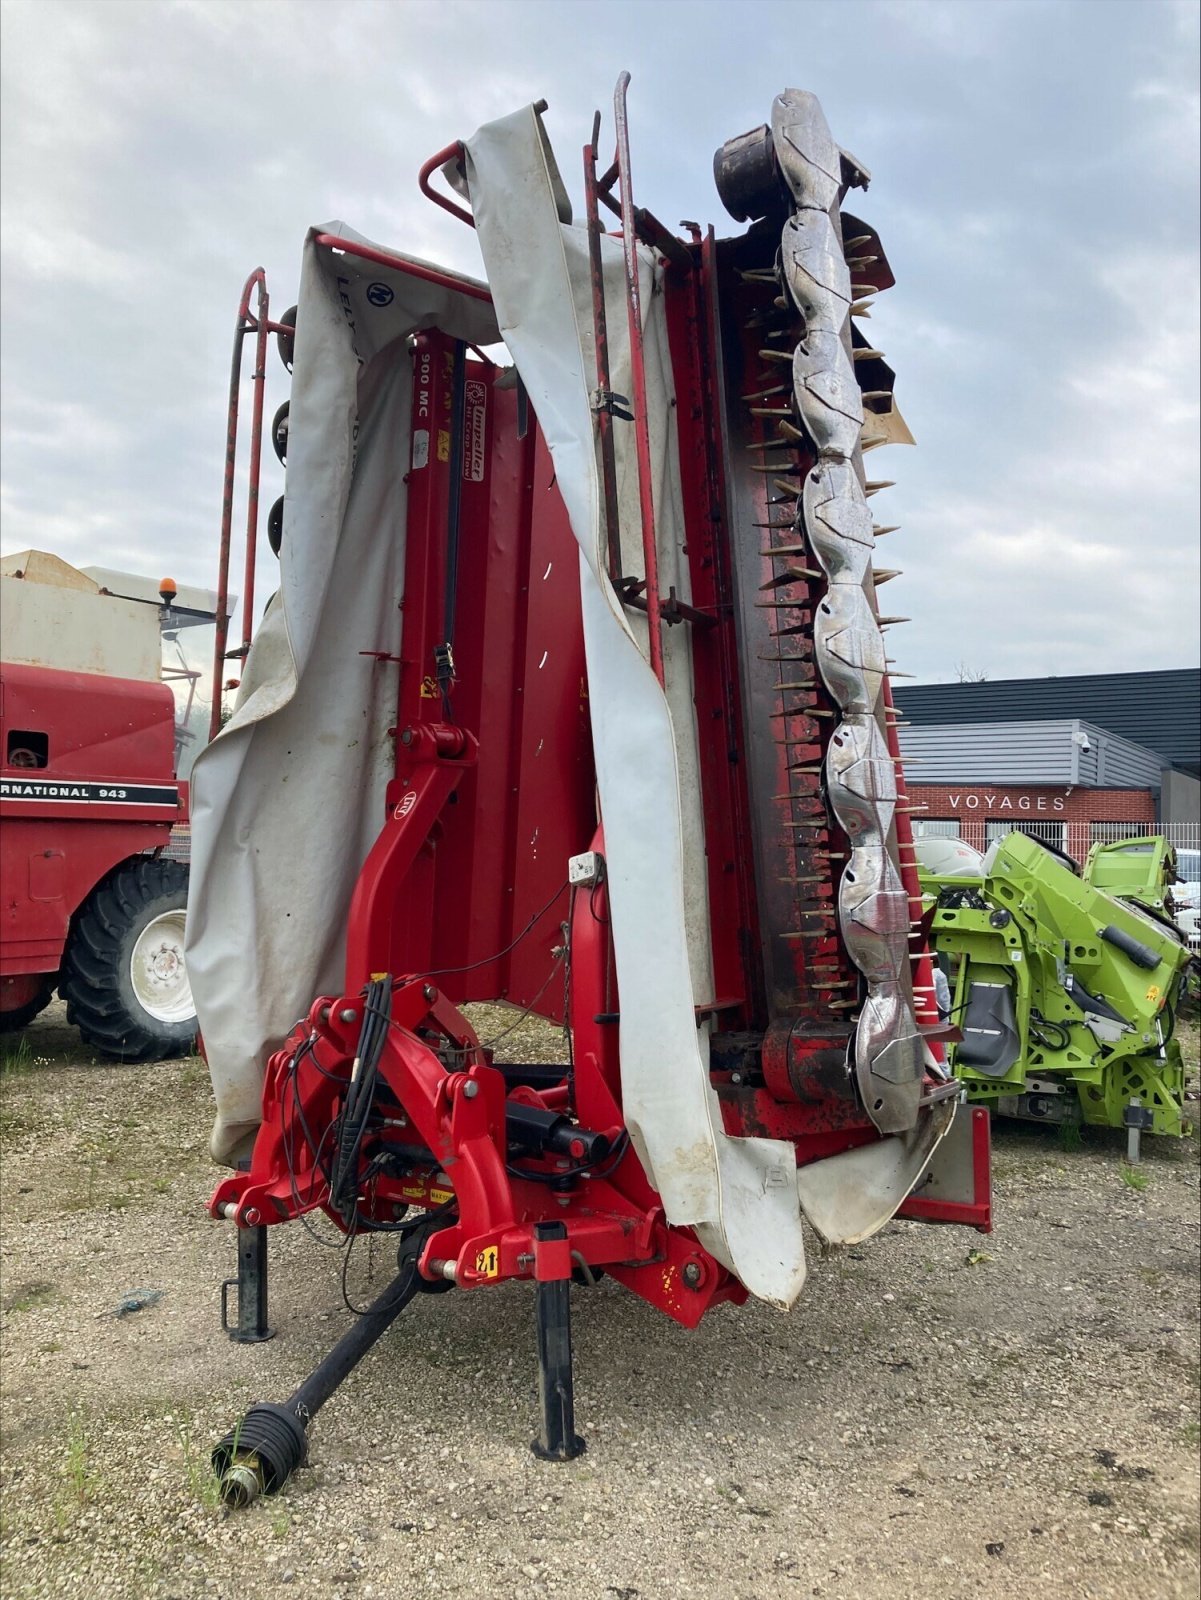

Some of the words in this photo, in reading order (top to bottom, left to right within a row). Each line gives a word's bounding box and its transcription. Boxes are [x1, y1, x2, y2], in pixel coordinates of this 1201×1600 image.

[420, 354, 430, 384] 900
[418, 390, 429, 417] MC
[464, 421, 472, 448] Crop
[473, 407, 484, 478] Impeller
[464, 451, 472, 478] Flow
[1, 785, 89, 797] RNATIONAL
[99, 789, 127, 798] 943
[949, 795, 1065, 811] VOYAGES
